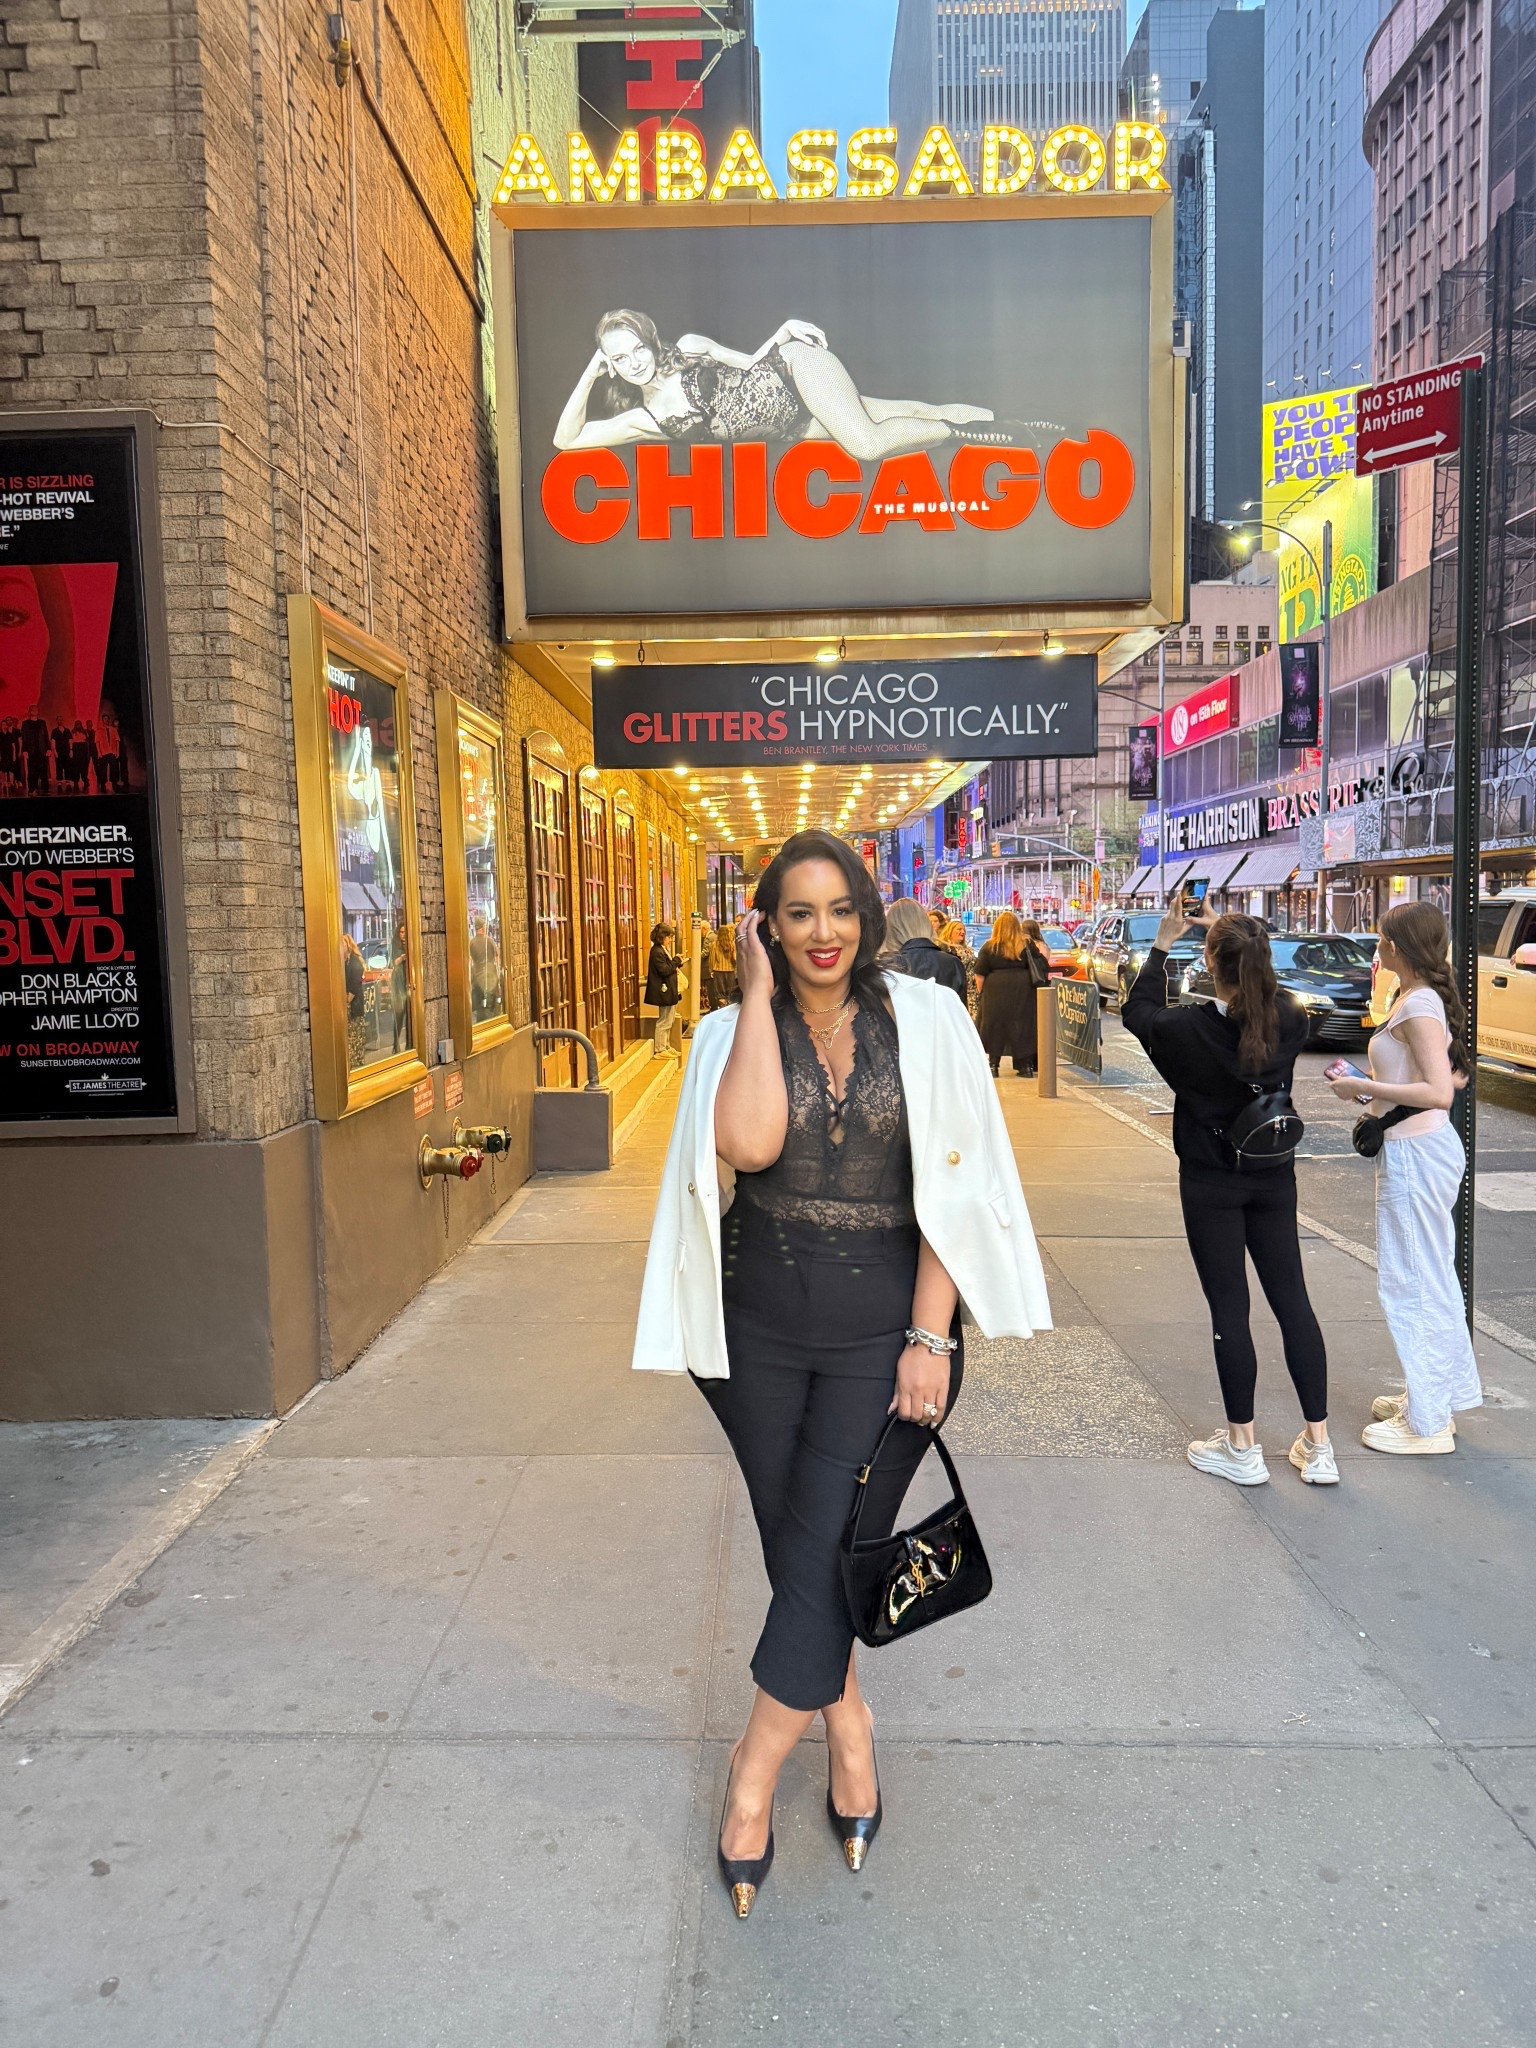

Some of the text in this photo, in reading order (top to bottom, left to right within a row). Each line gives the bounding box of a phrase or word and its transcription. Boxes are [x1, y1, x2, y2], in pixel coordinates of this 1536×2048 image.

[493, 121, 1171, 204] AMBASSADOR
[1362, 371, 1462, 414] NO STANDING
[1273, 400, 1325, 426] YOU
[1362, 404, 1424, 434] Anytime
[1273, 412, 1356, 448] PEOP
[1274, 437, 1334, 465] HAVE
[1275, 450, 1355, 483] POW
[9, 476, 24, 489] IS
[26, 474, 94, 489] SIZZLING
[540, 429, 1136, 545] CHICAGO
[35, 490, 95, 505] REVIVAL
[874, 500, 990, 515] THE MUSICAL
[0, 507, 75, 522] WEBBER’S
[1332, 558, 1364, 609] TSINGTAO
[751, 672, 939, 707] “CHICAGO
[328, 687, 362, 734] HOT
[623, 700, 1069, 745] GLITTERS HYPNOTICALLY.”
[1190, 713, 1198, 727] on
[1198, 703, 1211, 722] 15th
[1211, 698, 1228, 717] Floor
[763, 742, 928, 756] BEN BRANTLEY, THE NEW YORK TIMES
[1267, 779, 1362, 832] BRASSRIE
[1163, 797, 1260, 853] THE HARRISON
[45, 847, 135, 865] WEBBER’S
[21, 971, 138, 990] DON BLACK &
[51, 988, 138, 1005] HAMPTON
[31, 1012, 140, 1031] JAMIE LLOYD
[16, 1043, 41, 1056] ON
[45, 1040, 140, 1056] BROADWAY
[20, 1057, 141, 1068] SUNSETBLVDBROADWAY.COM
[72, 1080, 140, 1090] ST. JAMES THEATRE
